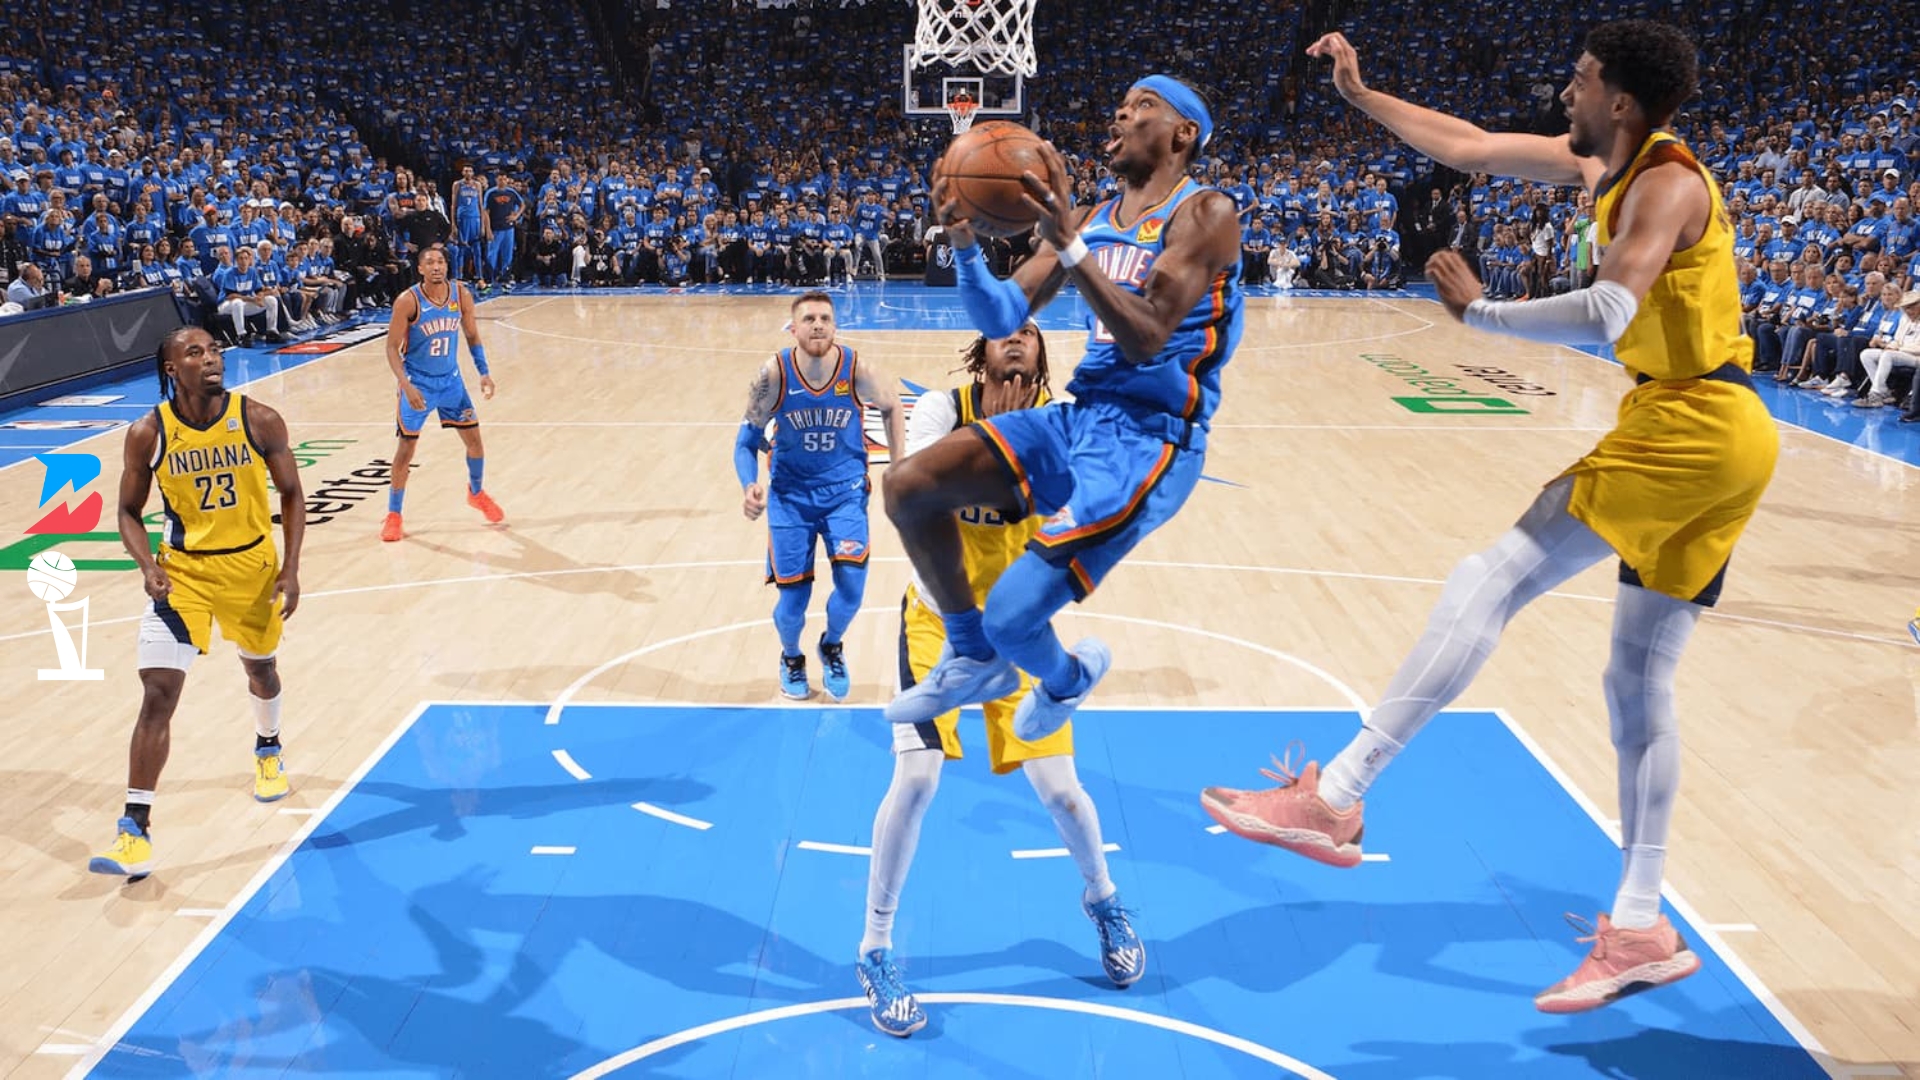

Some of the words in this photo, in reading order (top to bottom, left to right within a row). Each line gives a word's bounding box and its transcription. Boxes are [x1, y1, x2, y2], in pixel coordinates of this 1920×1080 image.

[1097, 243, 1156, 288] UNDE
[429, 337, 450, 357] 21
[785, 408, 852, 431] THUNDER
[803, 431, 836, 452] 55
[167, 442, 253, 476] INDIANA
[194, 472, 238, 513] 23
